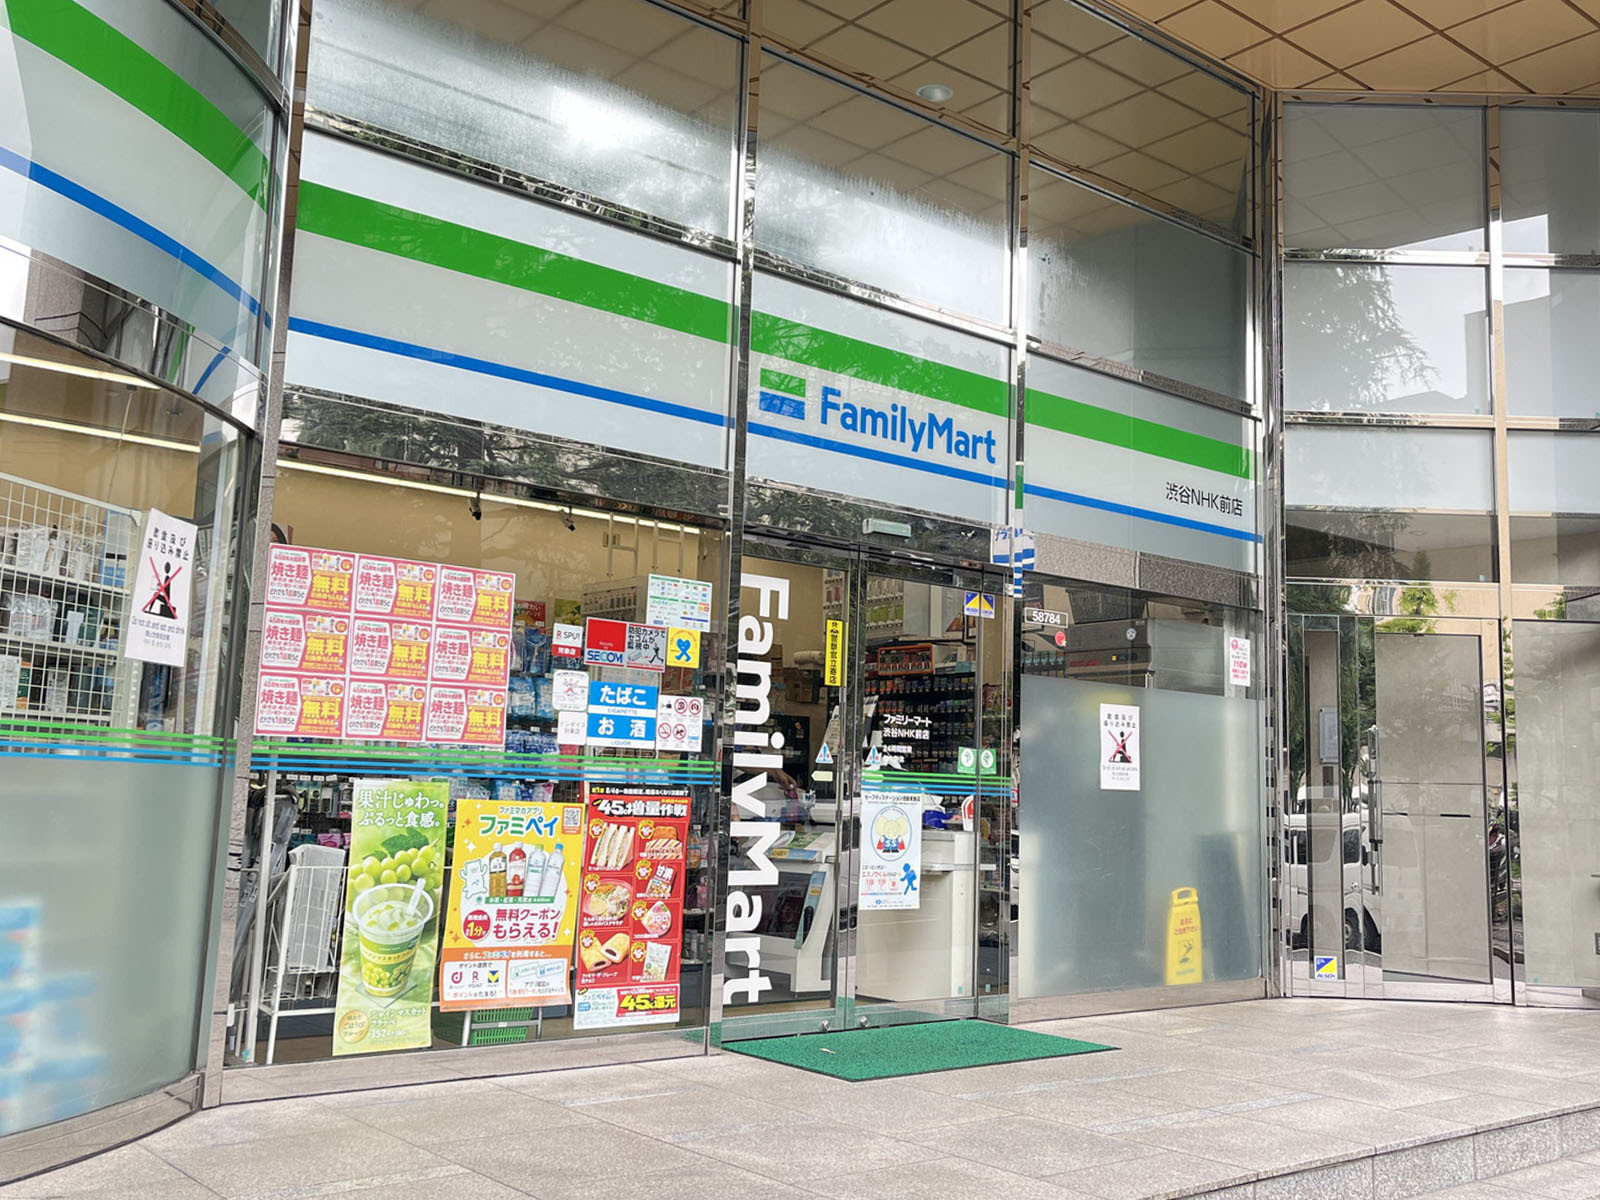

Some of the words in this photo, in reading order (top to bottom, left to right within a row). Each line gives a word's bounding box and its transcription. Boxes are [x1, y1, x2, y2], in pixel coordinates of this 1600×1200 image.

[820, 386, 996, 464] FamilyMart
[1166, 482, 1243, 517] 渋谷NHK前店
[271, 561, 308, 579] 焼き麺
[311, 574, 350, 594] 無料
[359, 571, 394, 588] 焼き麺
[397, 584, 432, 603] 無料
[441, 581, 473, 598] 焼き麺
[476, 593, 509, 612] 無料
[1032, 610, 1061, 625] 58784
[265, 624, 302, 642] 焼き麺
[354, 632, 389, 649] 焼き麺
[628, 634, 655, 644] セコムが
[629, 627, 665, 638] 防犯カメラで
[306, 636, 344, 656] 無料
[392, 644, 427, 663] 無料
[436, 639, 469, 656] 焼き麺
[628, 642, 649, 650] 監視中
[472, 651, 505, 669] 無料
[587, 650, 623, 663] SECOM
[260, 688, 298, 705] 焼き麺
[350, 694, 384, 710] 焼き麺
[600, 685, 647, 705] たばこ
[302, 700, 340, 719] 無料
[387, 705, 422, 723] 無料
[431, 699, 464, 715] 焼き麺
[467, 710, 501, 727] 無料
[883, 714, 932, 727] ファミリーマート
[883, 727, 929, 740] 渋谷NHK前店
[722, 573, 789, 1005] FamilyMart
[358, 790, 444, 809] 果汁じゅわっ。
[499, 806, 543, 815] ファミマのアプリ
[359, 811, 440, 828] ぷるっと食感。
[480, 815, 559, 836] ファミペイ
[496, 908, 561, 922] 無料クーポン
[493, 922, 558, 939] もらえる!
